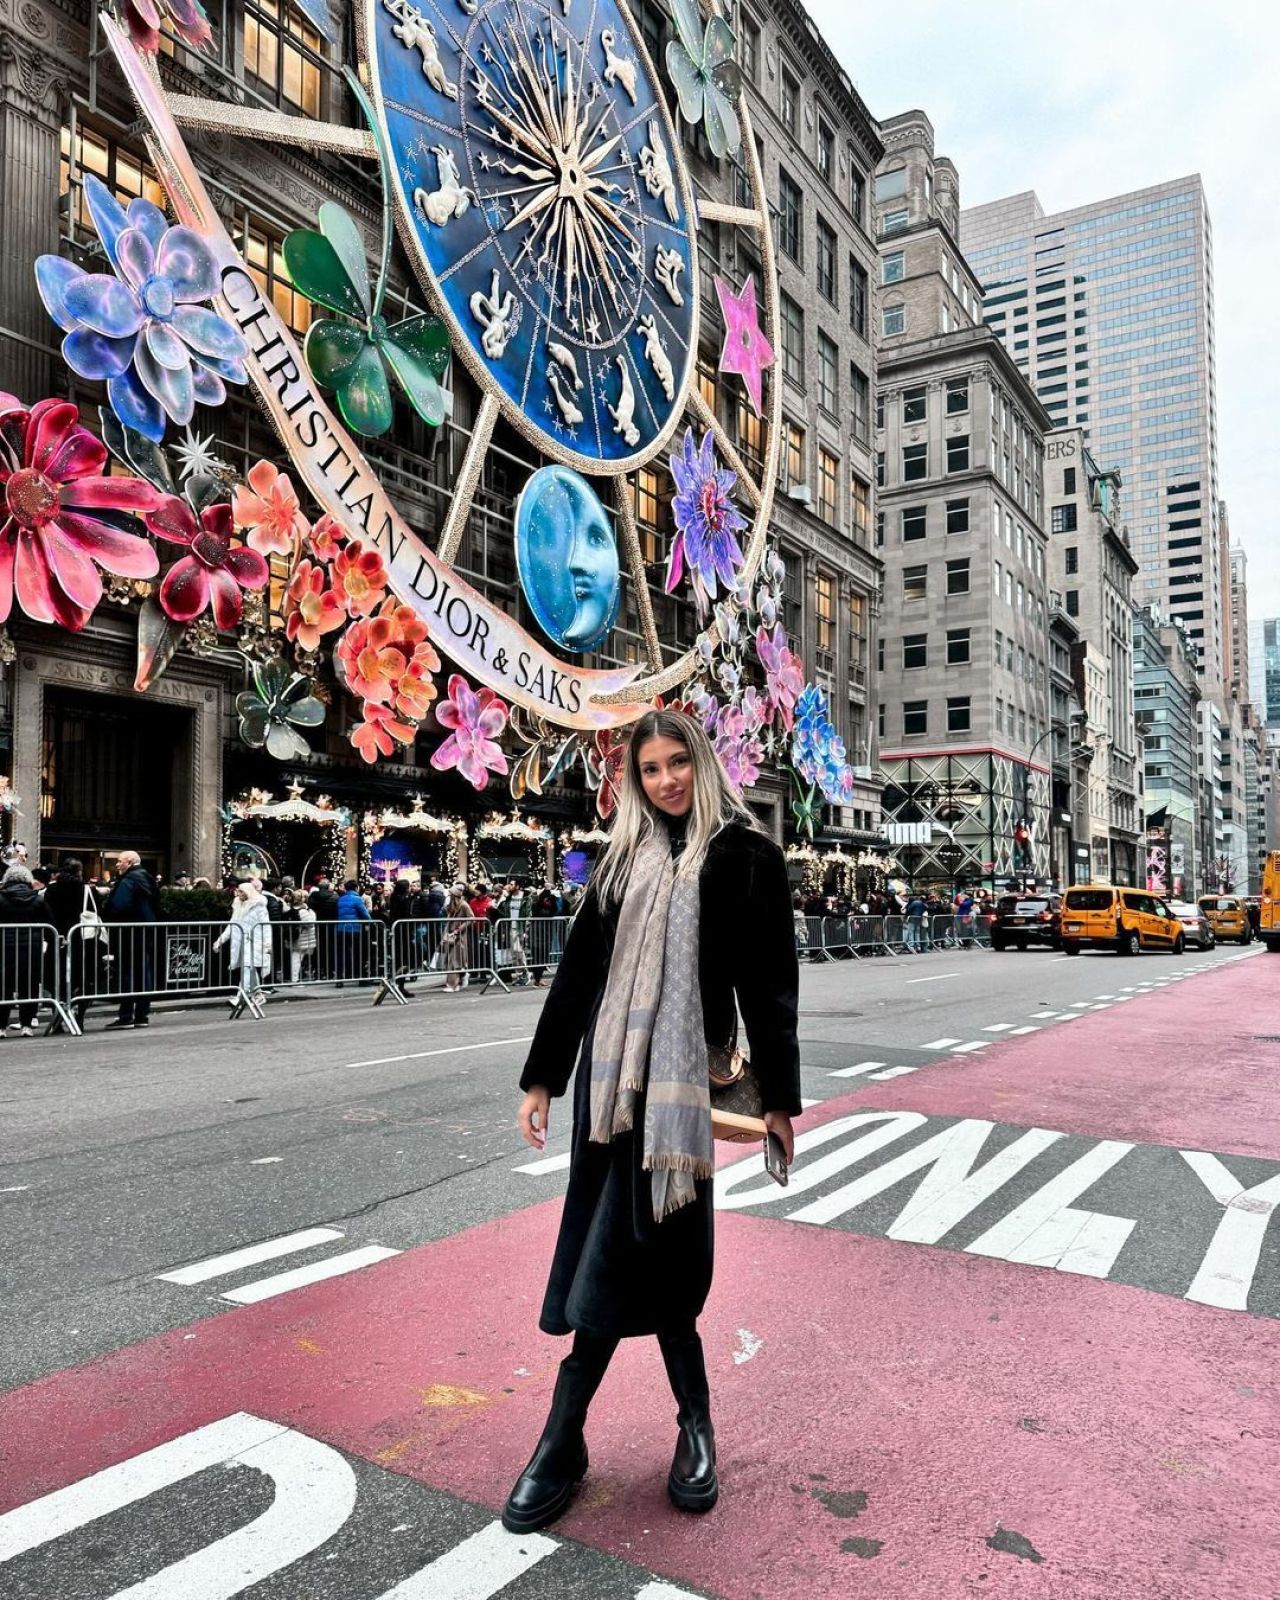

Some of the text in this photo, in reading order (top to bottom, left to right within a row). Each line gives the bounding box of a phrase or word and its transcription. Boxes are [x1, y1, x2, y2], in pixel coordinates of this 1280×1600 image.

[1043, 439, 1076, 461] ERS
[221, 265, 581, 713] CHRISTIAN DIOR & SAKS
[54, 661, 195, 699] SAKS & COPANY
[880, 822, 931, 845] UMA
[712, 1111, 1280, 1312] ONLY
